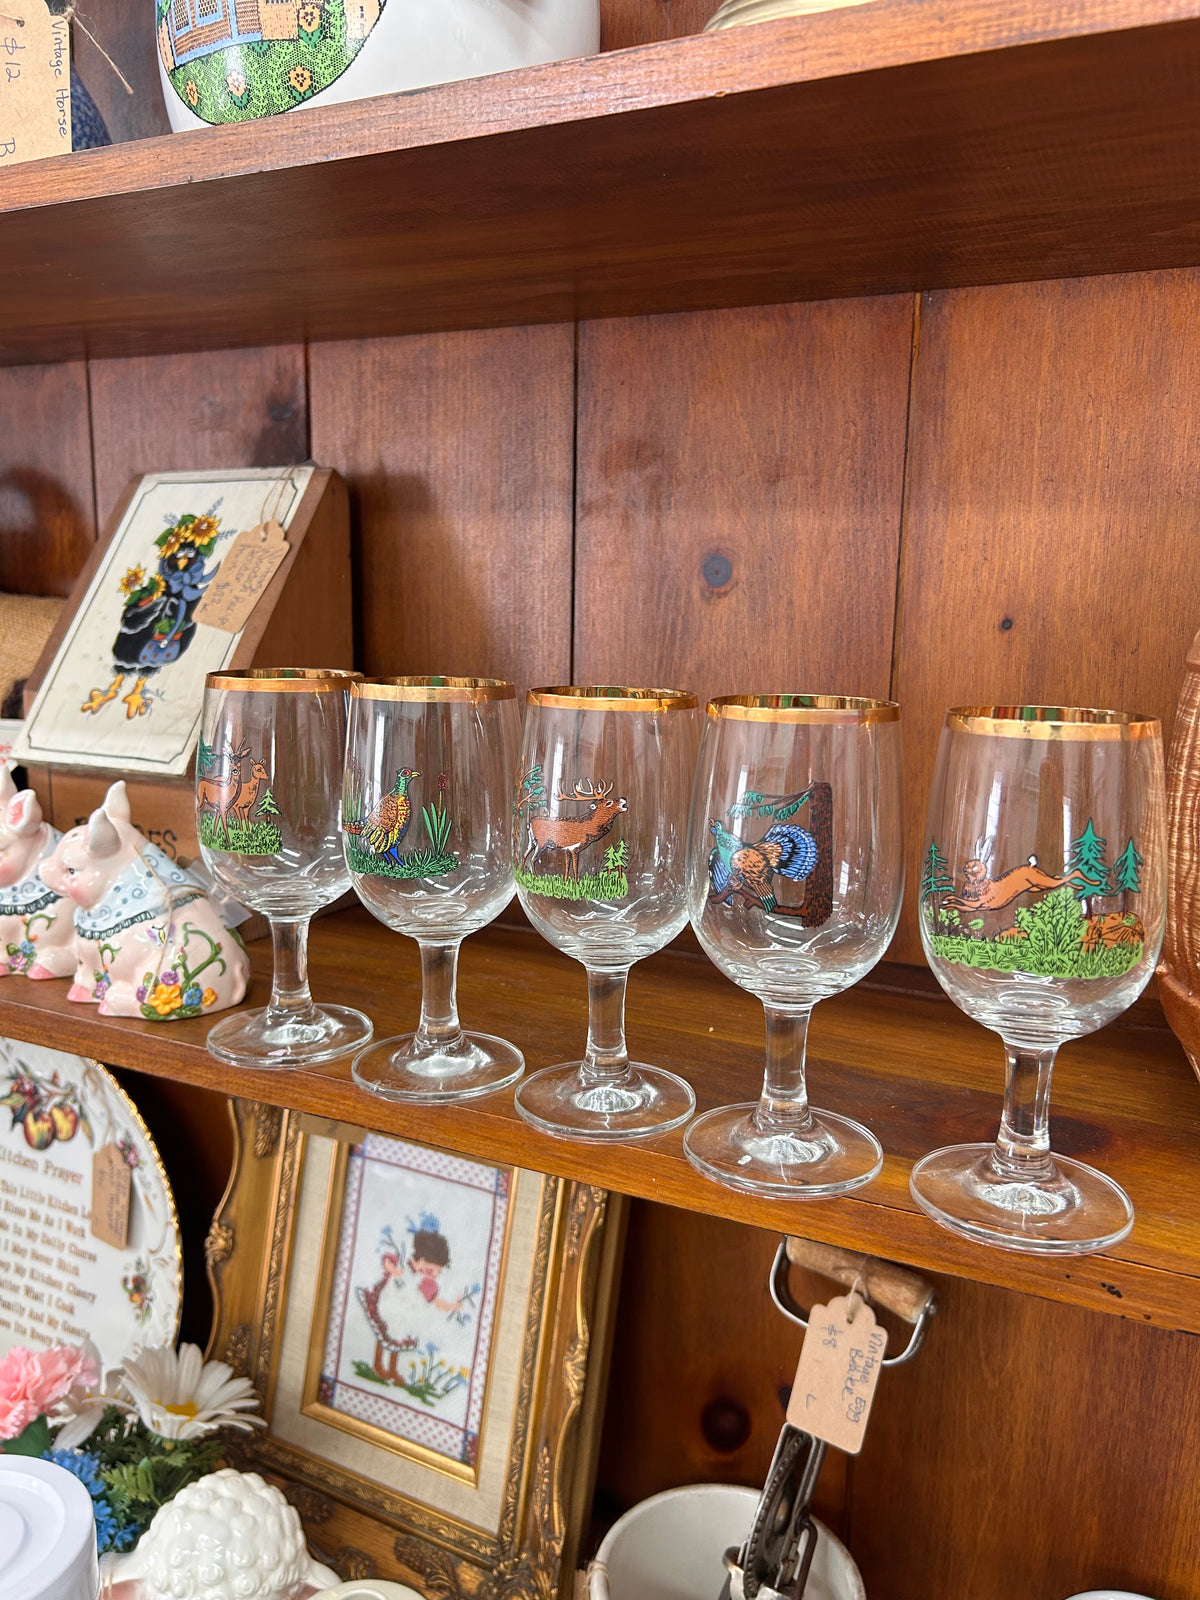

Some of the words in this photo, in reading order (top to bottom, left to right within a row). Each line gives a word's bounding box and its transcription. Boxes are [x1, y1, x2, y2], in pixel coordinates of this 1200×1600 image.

[0, 37, 26, 83] $12
[49, 20, 67, 79] Vintage
[56, 88, 70, 138] Horse
[43, 1158, 84, 1185] Prayer
[47, 1194, 79, 1216] Kitchen
[29, 1267, 63, 1291] Kitchen
[820, 1324, 844, 1348] $8
[859, 1332, 883, 1384] Vintage
[846, 1396, 867, 1423] Egg
